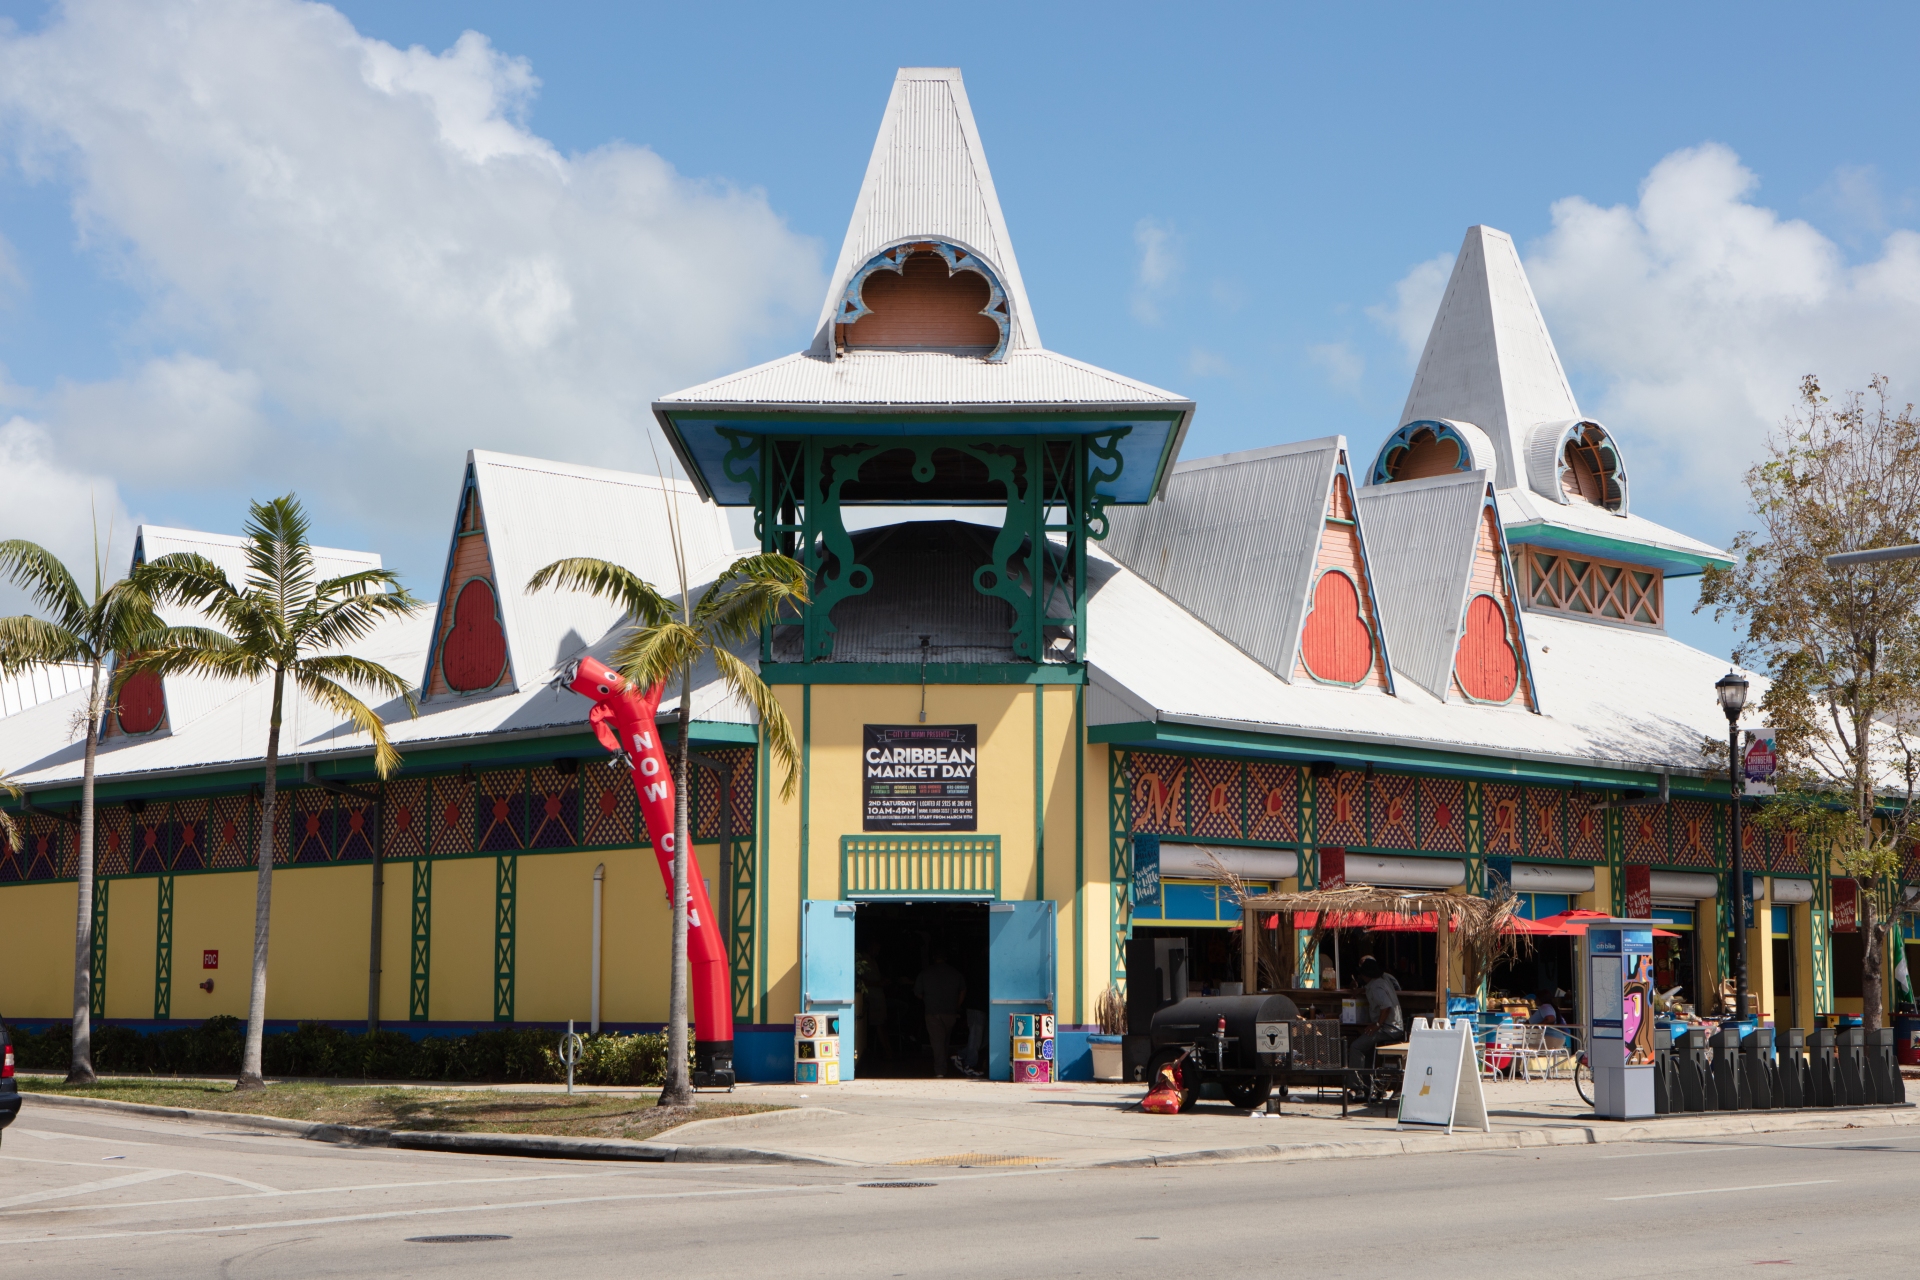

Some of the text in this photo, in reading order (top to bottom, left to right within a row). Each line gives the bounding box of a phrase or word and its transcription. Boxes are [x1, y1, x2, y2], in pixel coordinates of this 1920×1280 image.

[866, 748, 975, 764] CARIBBEAN
[632, 731, 668, 803] NOW
[868, 765, 975, 778] MARKET DAY
[1135, 765, 1402, 827] Mache
[204, 954, 216, 965] FDC
